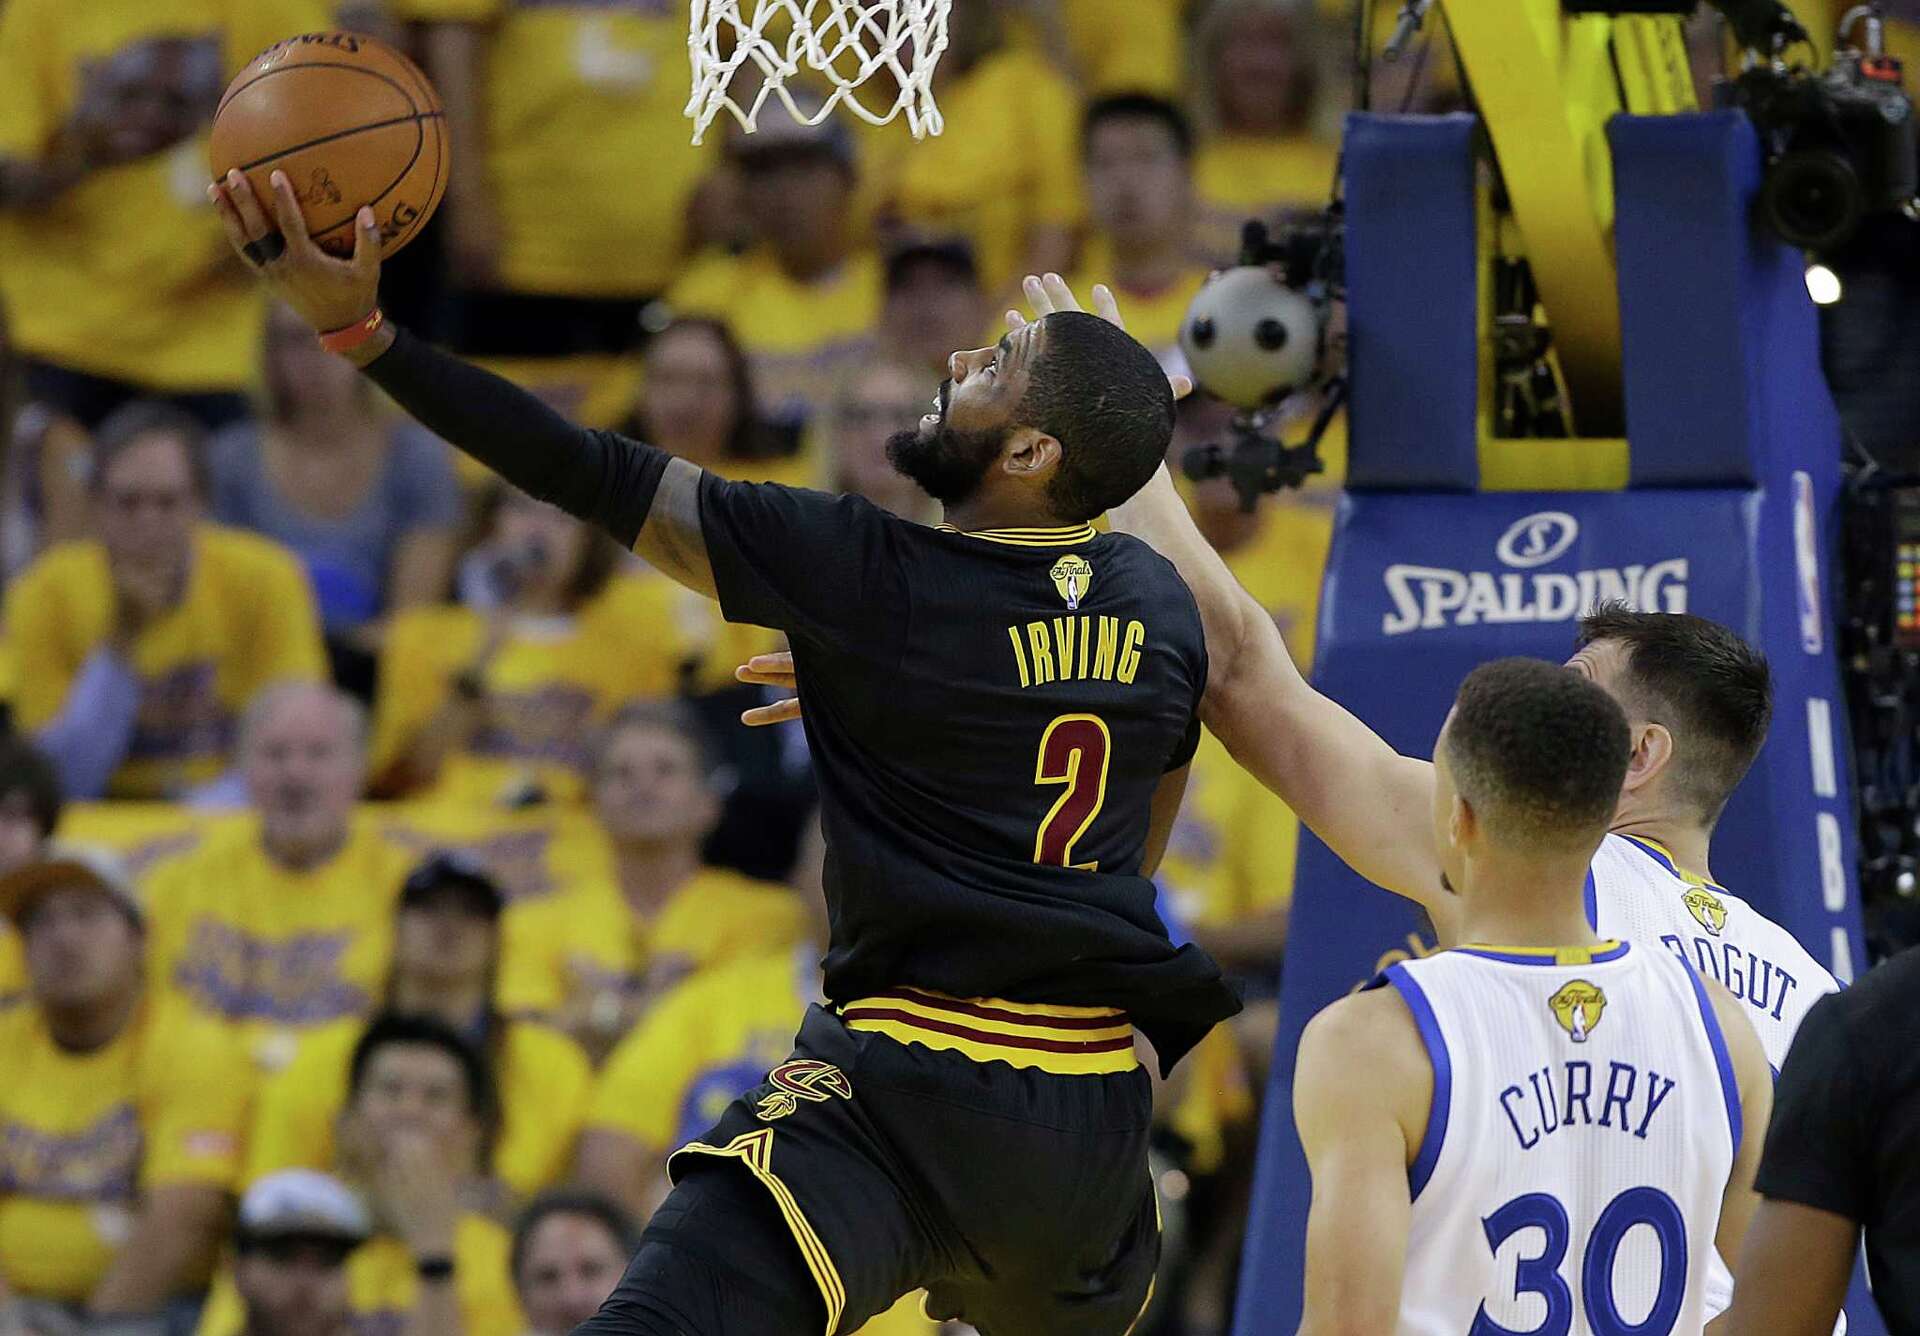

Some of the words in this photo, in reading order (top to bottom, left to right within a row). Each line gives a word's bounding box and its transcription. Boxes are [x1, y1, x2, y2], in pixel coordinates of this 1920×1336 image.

[1382, 557, 1689, 636] SPALDING
[1007, 615, 1145, 689] IRVING
[1033, 713, 1111, 873] 2
[1500, 1060, 1676, 1151] CURRY
[1468, 1186, 1688, 1336] 30
